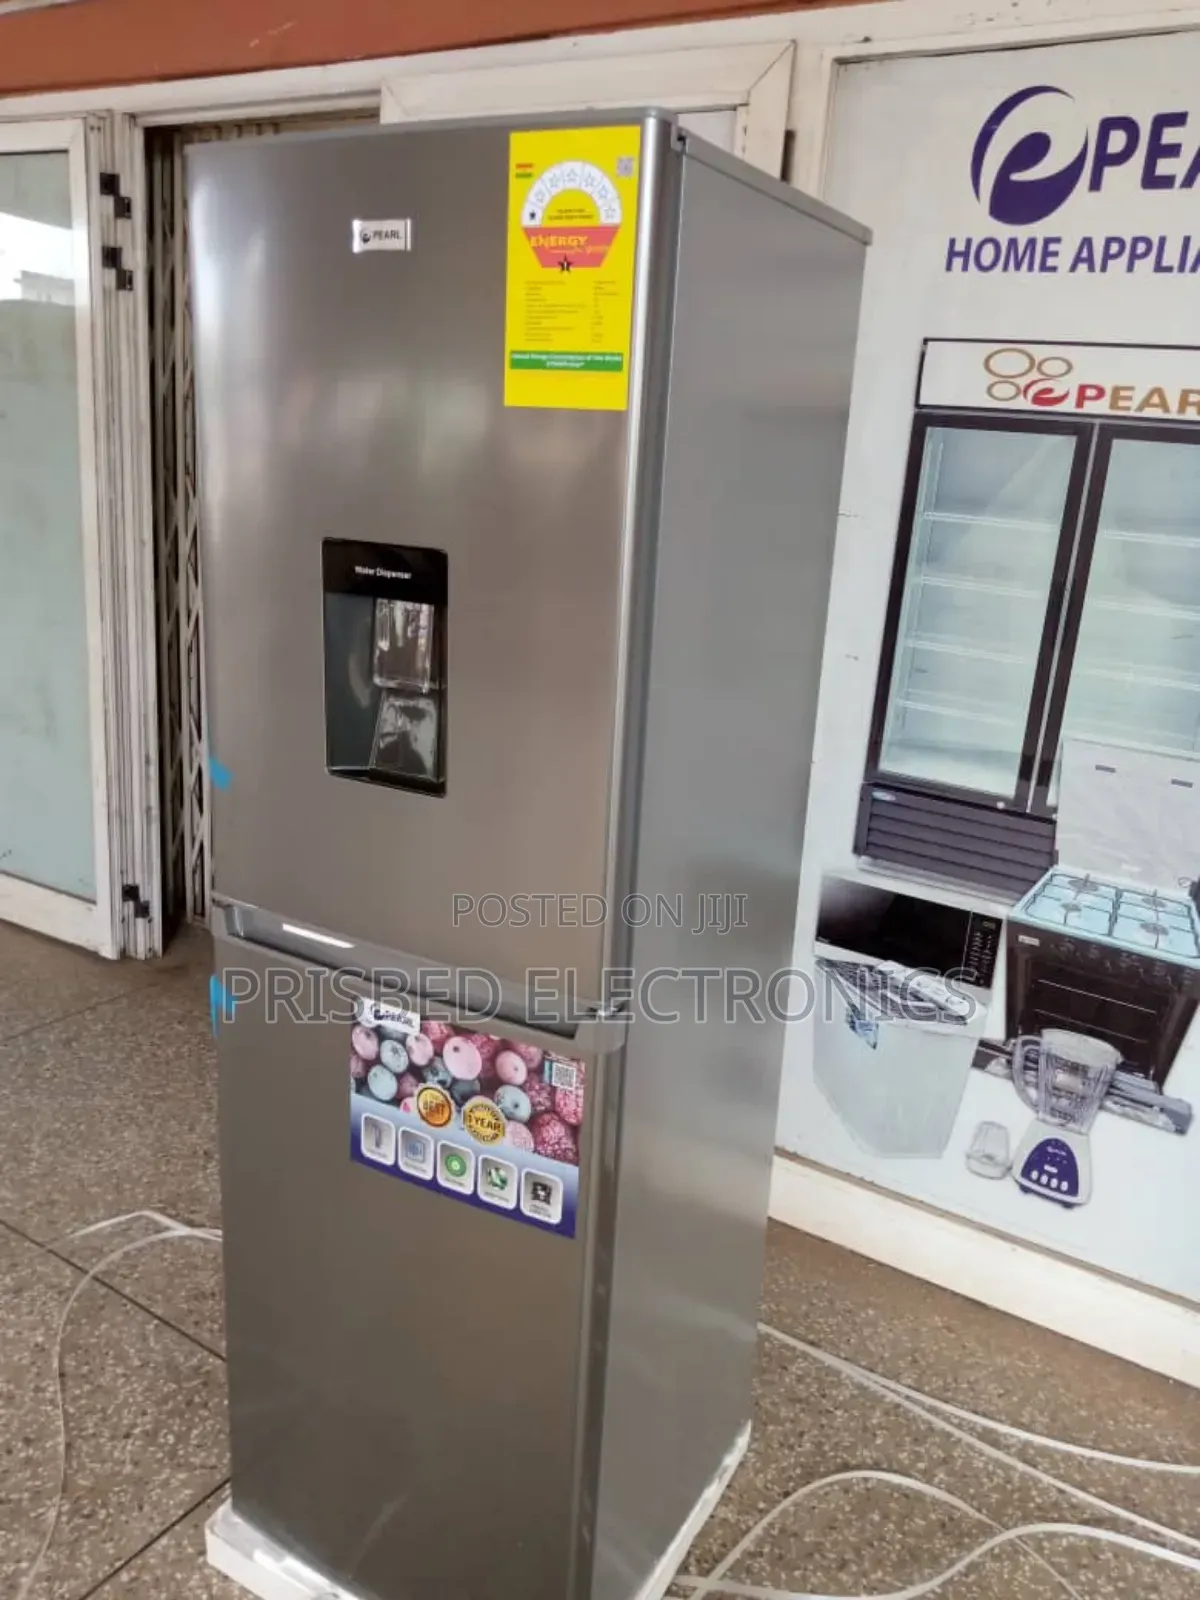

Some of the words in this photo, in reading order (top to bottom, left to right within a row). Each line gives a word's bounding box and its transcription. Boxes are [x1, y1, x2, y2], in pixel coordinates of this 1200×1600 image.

[372, 229, 402, 241] PEARL
[530, 234, 588, 250] ENERGY
[945, 236, 1062, 273] HOME
[475, 1116, 502, 1132] YEAR
